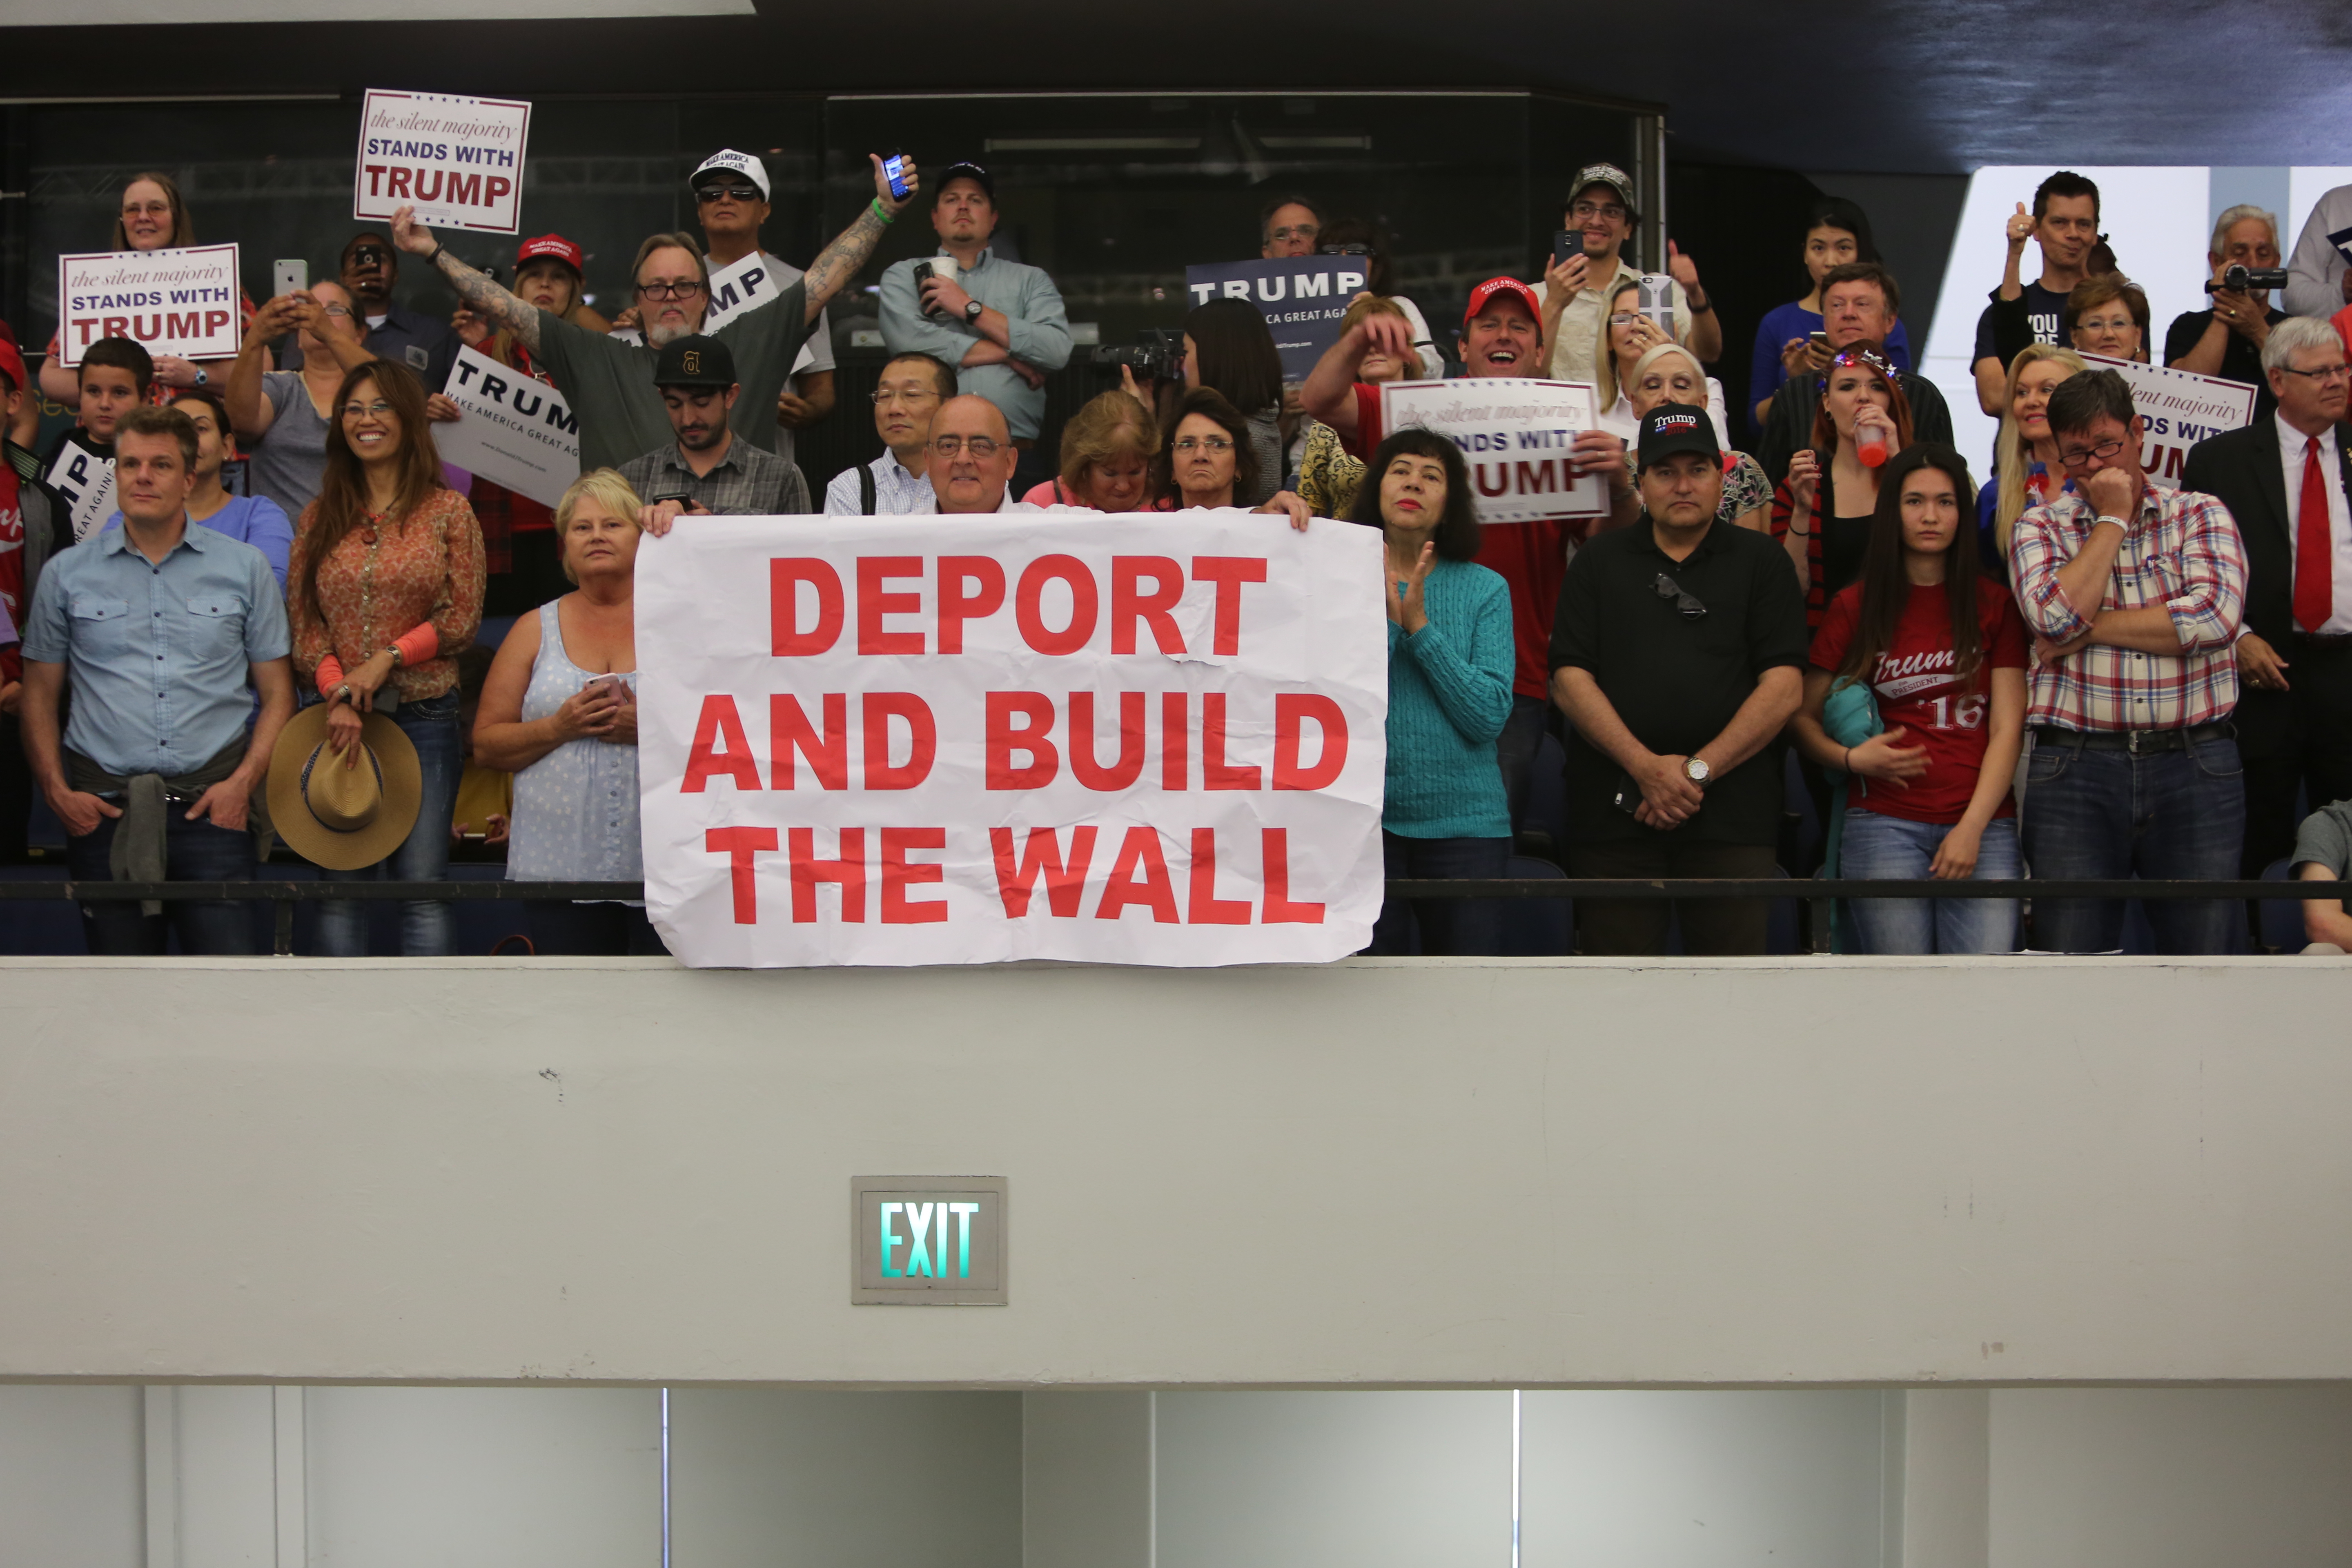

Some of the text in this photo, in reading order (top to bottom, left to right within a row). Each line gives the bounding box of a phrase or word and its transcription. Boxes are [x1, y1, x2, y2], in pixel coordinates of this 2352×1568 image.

[370, 109, 518, 145] the silent majority
[367, 138, 514, 167] STANDS WITH
[365, 165, 511, 207] TRUMP
[71, 263, 229, 287] the silent majority
[1190, 271, 1365, 306] TRUMP
[1481, 281, 1499, 292] MAKE
[1500, 279, 1528, 293] AMERICA
[71, 287, 229, 310] STANDS WITH
[71, 310, 230, 345] TRUMP
[1284, 310, 1320, 323] GREAT
[1492, 399, 1588, 425] majority
[1655, 414, 1697, 428] Trump
[2163, 395, 2243, 425] majority
[476, 407, 524, 434] AMERICA
[527, 429, 563, 449] GREAT
[1666, 427, 1687, 436] 2016
[2178, 421, 2230, 443] WIT
[89, 472, 115, 513] AGAIN!
[770, 553, 1267, 657] DEPORT
[1874, 646, 1984, 684] Trum
[1891, 677, 1939, 695] PRESIDENT
[680, 691, 1349, 793] AND BUILD
[705, 825, 1325, 925] THE WALL
[880, 1202, 980, 1278] EXIT
